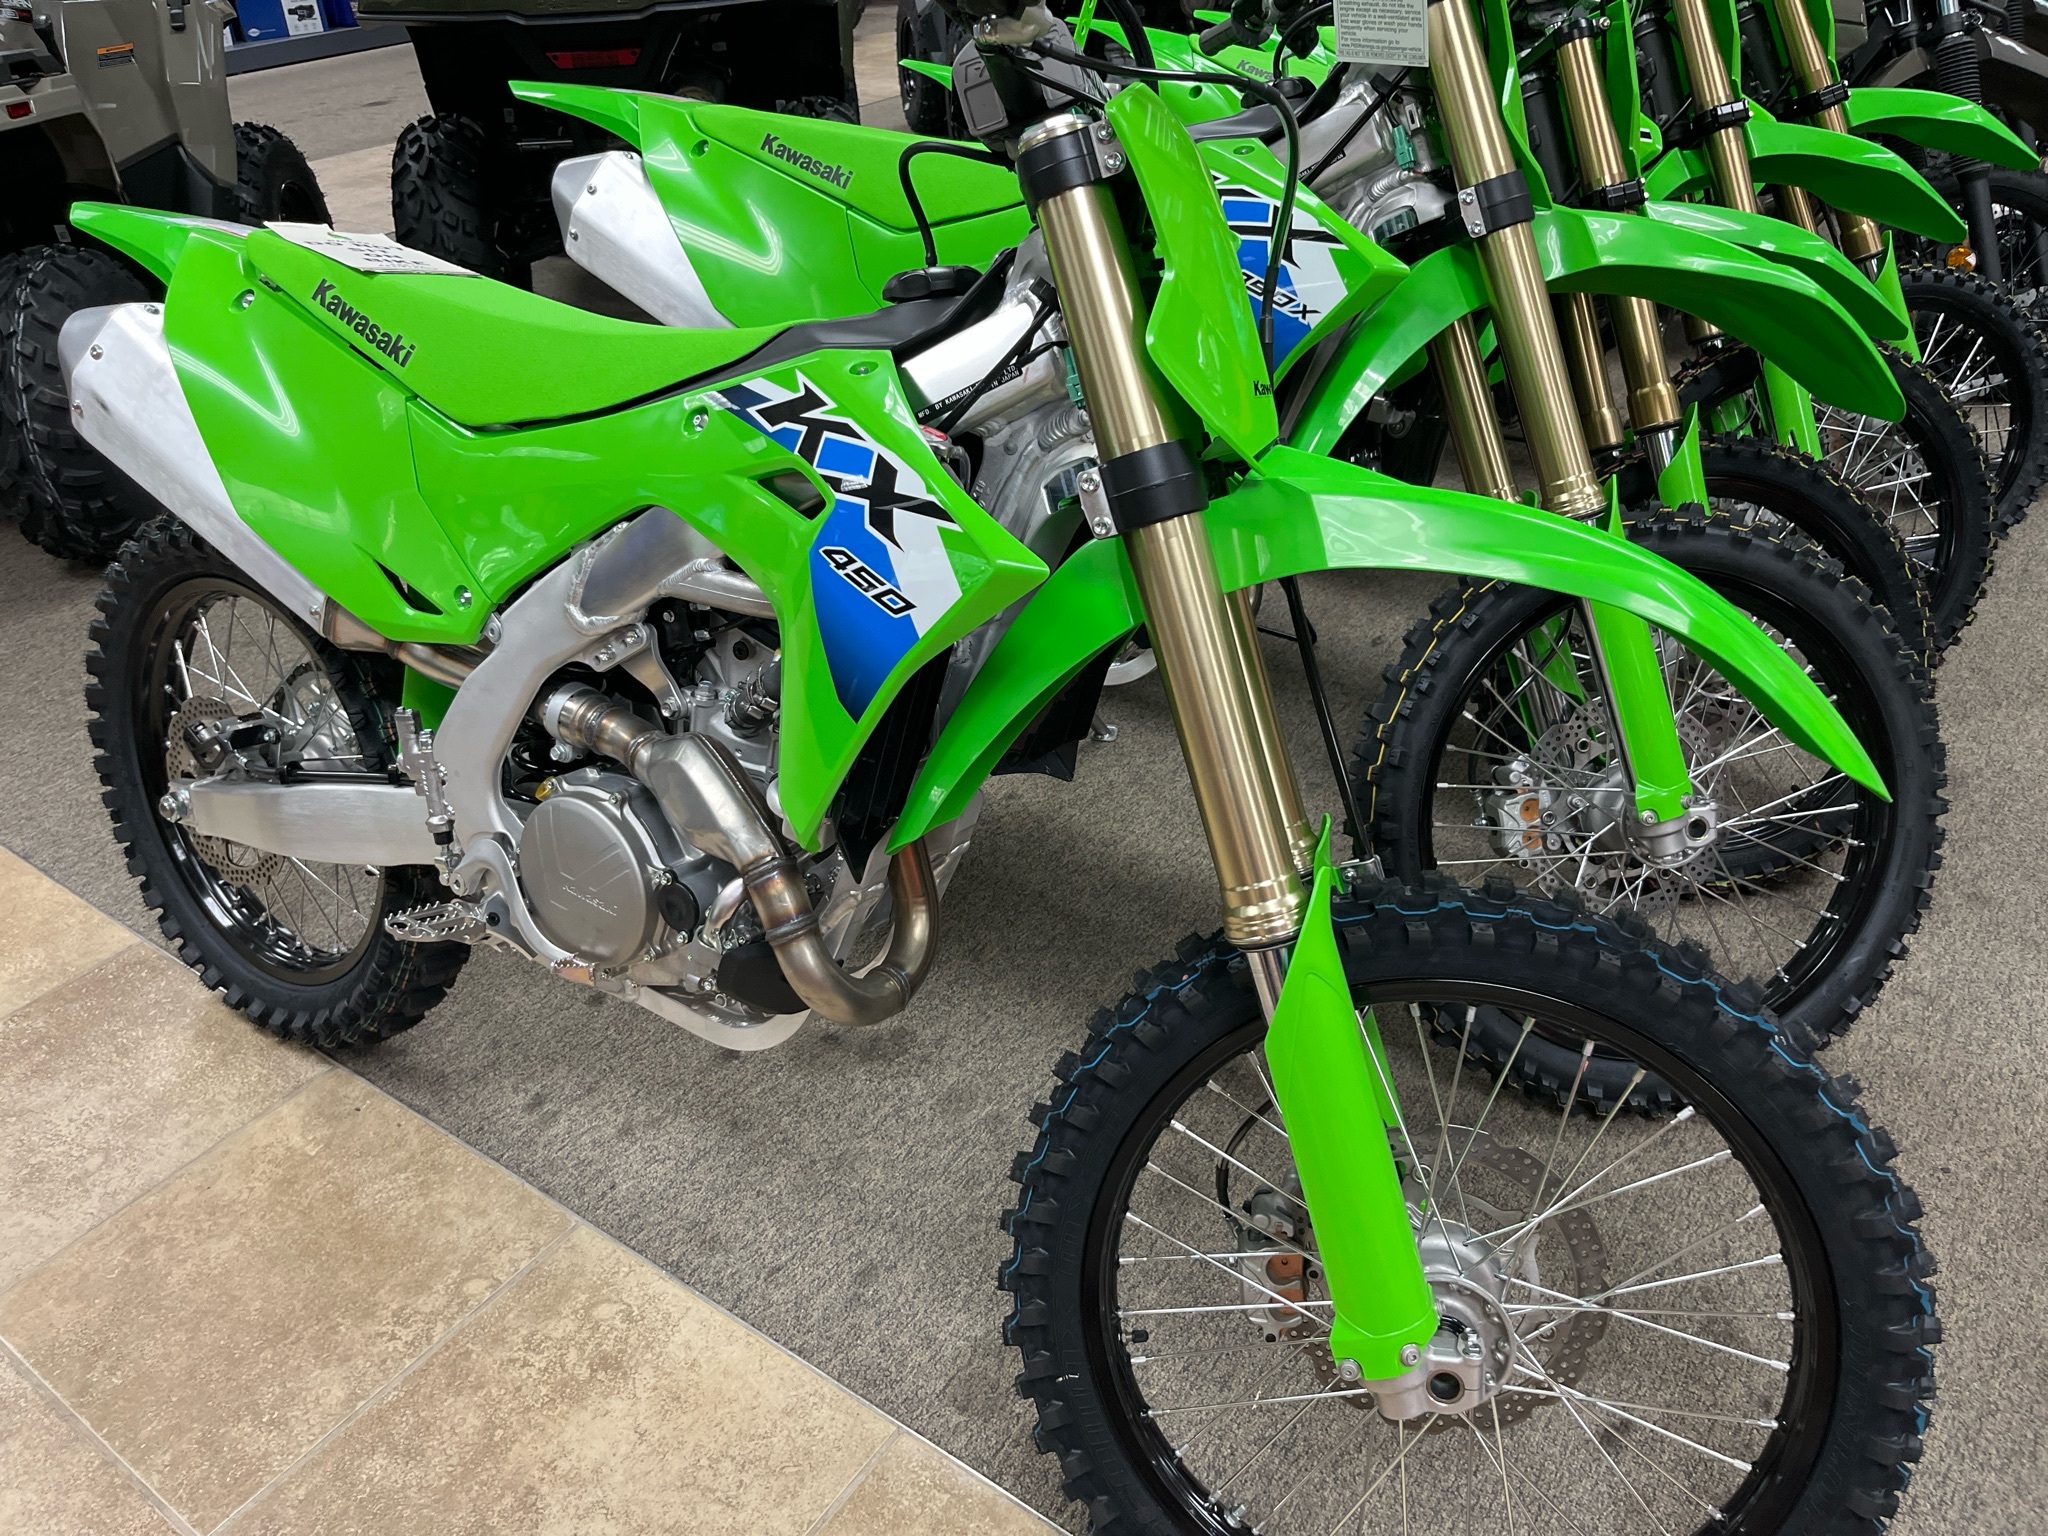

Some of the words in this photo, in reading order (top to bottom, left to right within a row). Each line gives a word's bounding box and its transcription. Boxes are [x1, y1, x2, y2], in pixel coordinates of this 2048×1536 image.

[760, 133, 855, 191] Kawasaki
[312, 278, 417, 369] Kawasaki
[917, 409, 932, 419] MFD.
[935, 402, 943, 411] BY
[945, 386, 974, 405] KAWASAKI
[1001, 370, 1020, 383] JAPAN
[755, 381, 957, 553] KX
[820, 547, 918, 616] 450
